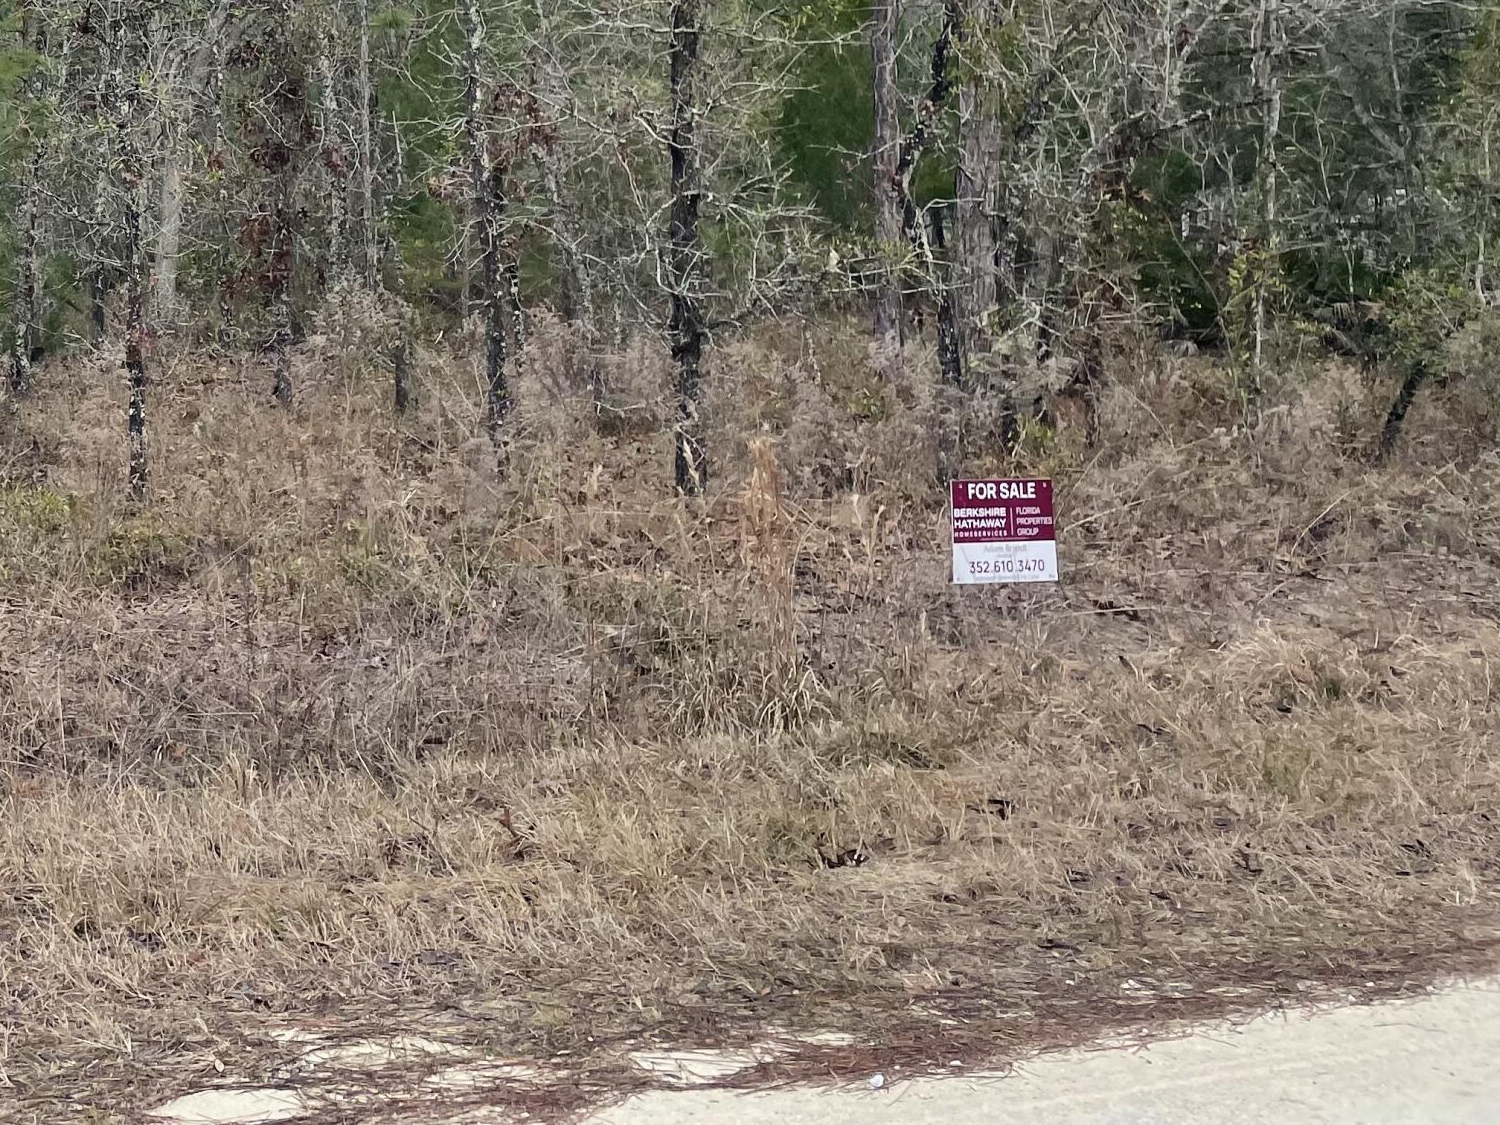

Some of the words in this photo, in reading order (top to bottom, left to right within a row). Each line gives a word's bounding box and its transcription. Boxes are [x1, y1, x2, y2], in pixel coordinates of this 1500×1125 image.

[968, 483, 997, 500] FOR
[1000, 482, 1036, 499] SALE
[953, 507, 1007, 518] BERKSHIRE
[1015, 506, 1040, 515] FLORIDA
[954, 518, 1007, 529] HATHAWAY
[1016, 516, 1053, 525] PROPERTIES
[954, 530, 1008, 538] HOMESERVICES
[1016, 527, 1039, 536] GROUP
